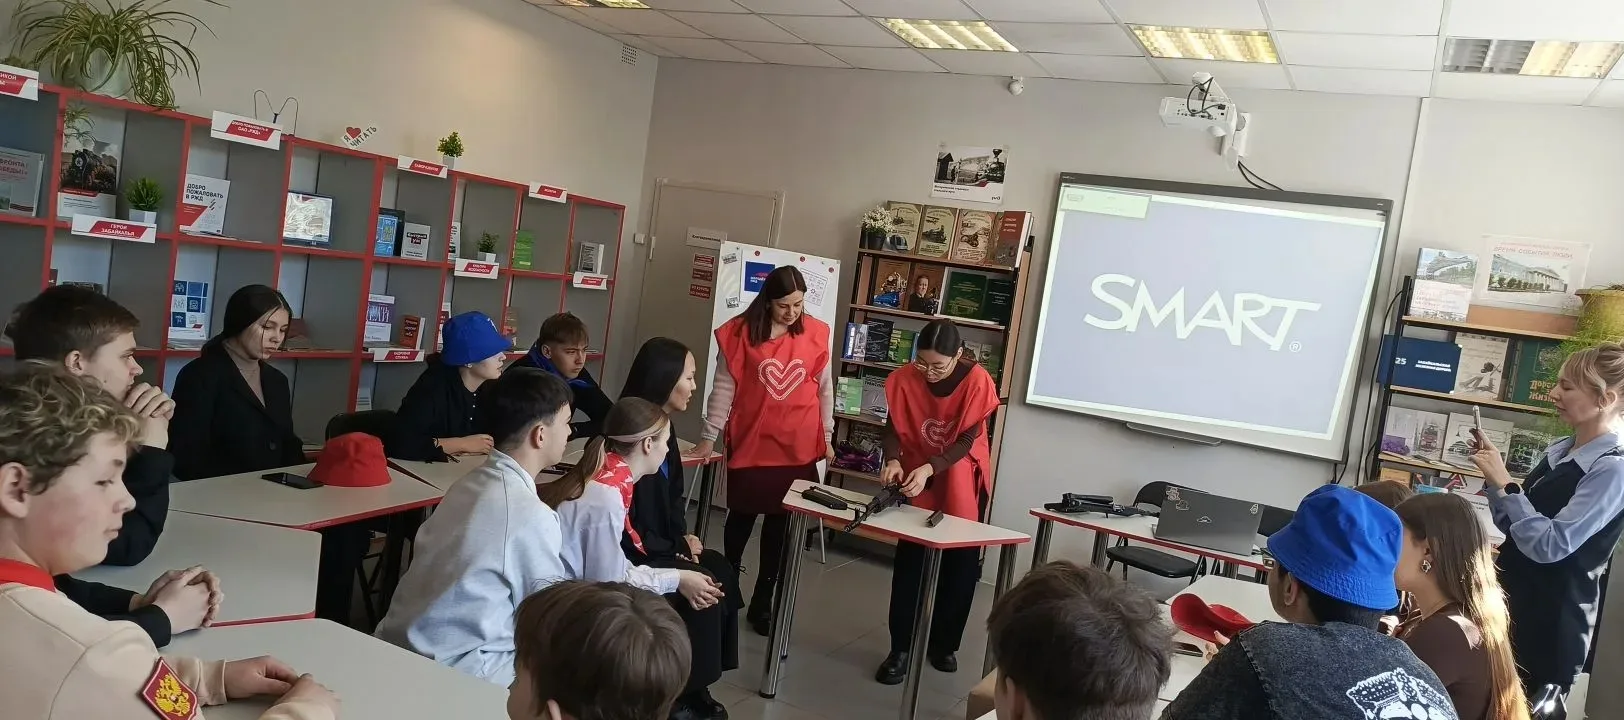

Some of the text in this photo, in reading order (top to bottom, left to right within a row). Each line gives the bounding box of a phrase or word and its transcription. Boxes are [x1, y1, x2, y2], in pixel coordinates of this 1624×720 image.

[350, 126, 377, 147] ЧИТАТЬ
[187, 183, 206, 191] ДОБРО
[186, 189, 224, 199] ПОЖАЛОВАТЬ
[101, 228, 135, 236] ЗАБАЙКАЛЬЯ
[1083, 273, 1322, 352] SMART
